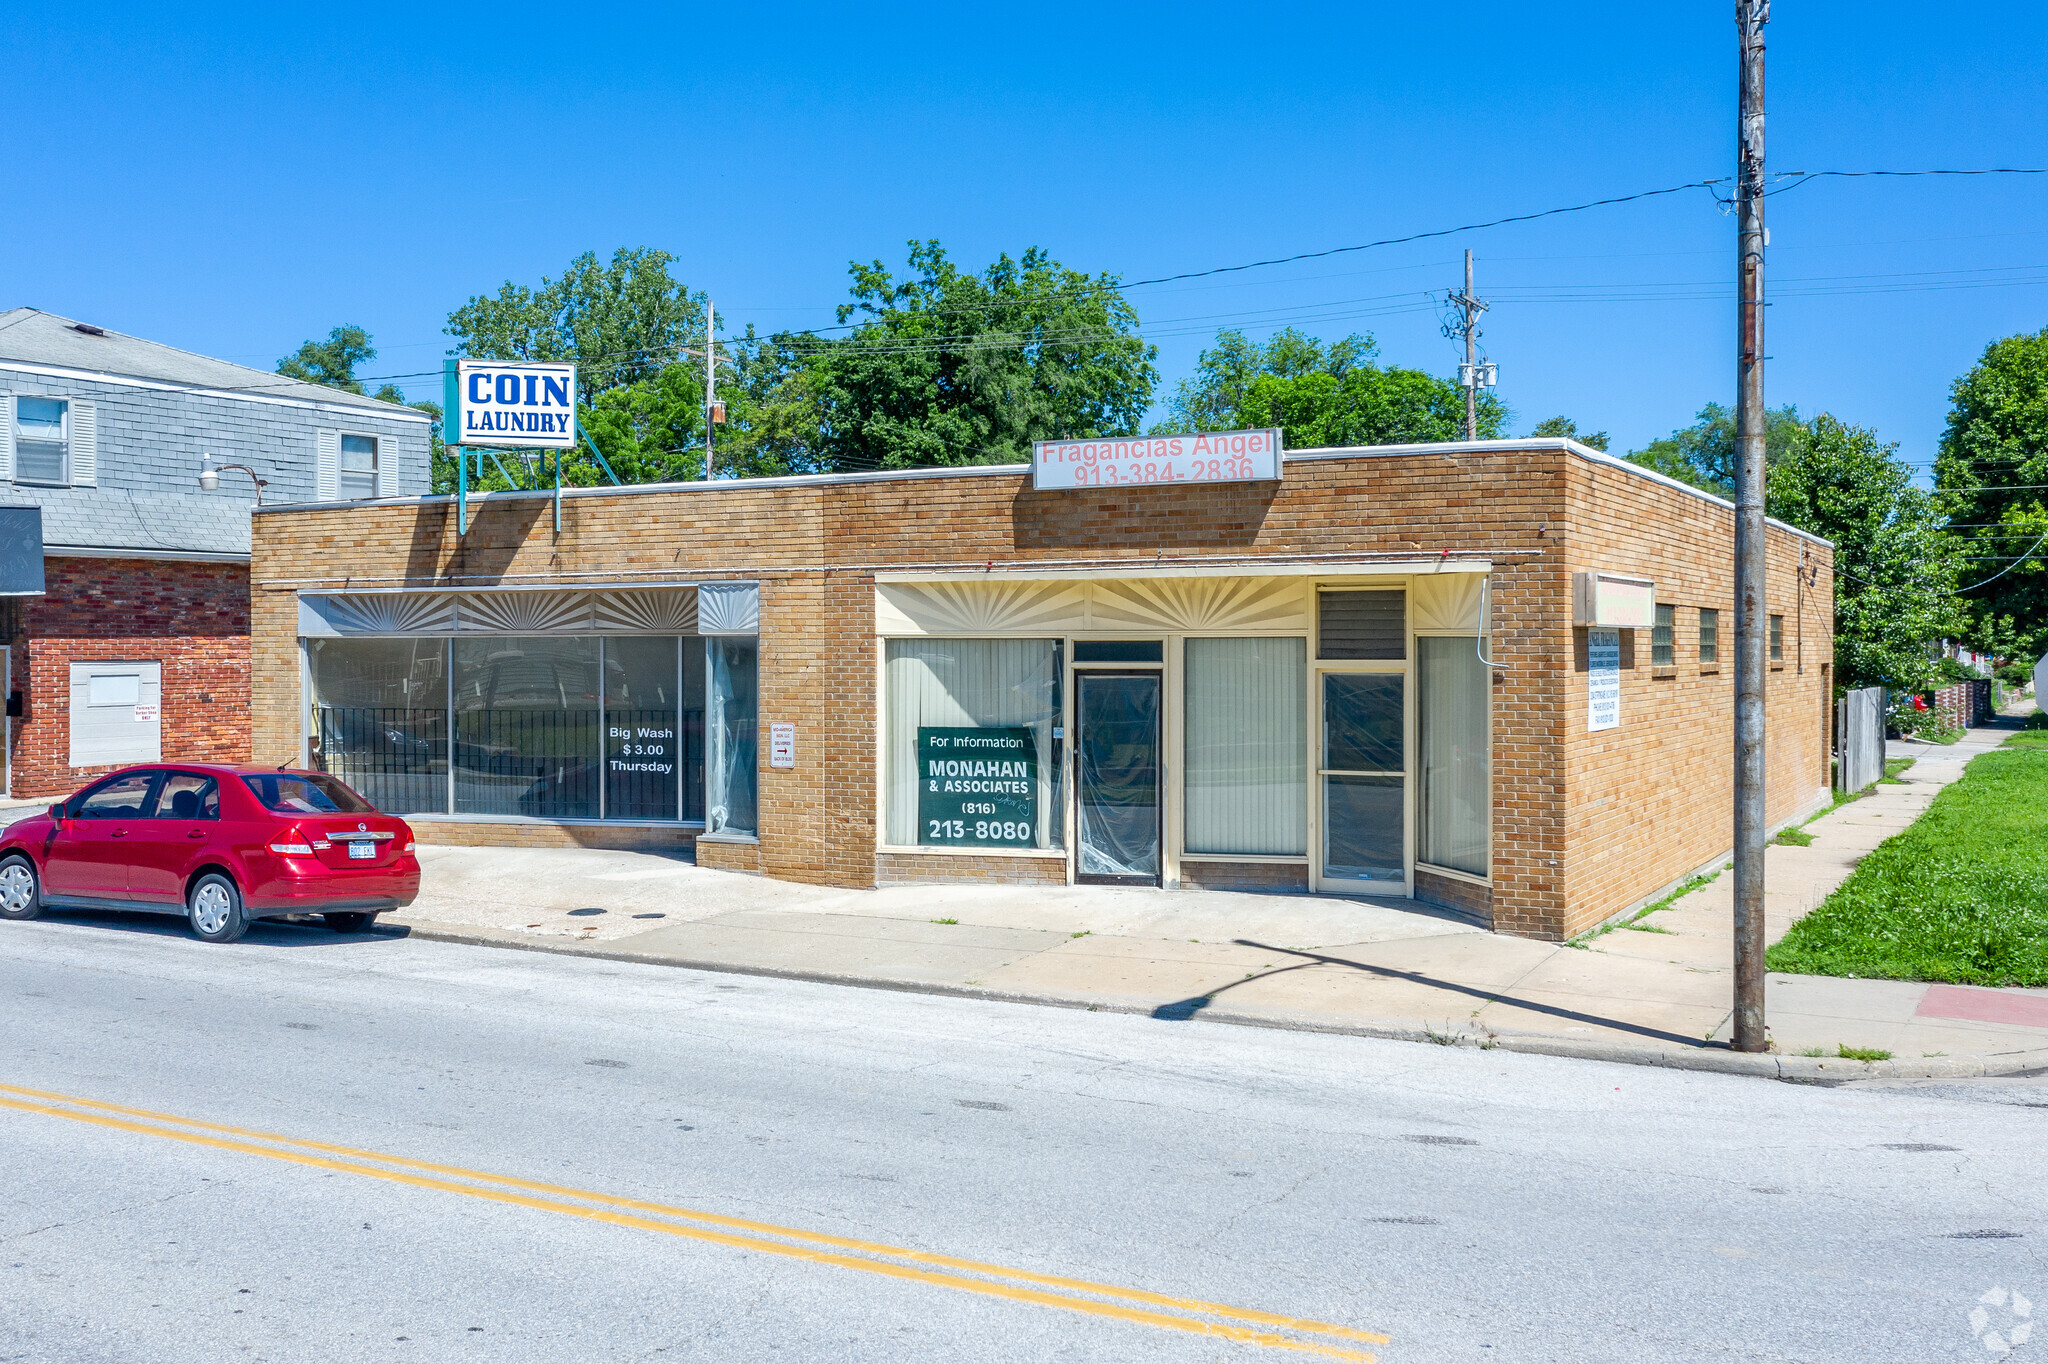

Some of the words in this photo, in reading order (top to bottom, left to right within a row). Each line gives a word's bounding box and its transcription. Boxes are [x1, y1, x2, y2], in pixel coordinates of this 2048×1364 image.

[469, 373, 570, 407] COIN
[466, 410, 570, 433] LAUNDRY
[1042, 437, 1184, 467] Fragancias
[1192, 430, 1271, 460] Angel
[1191, 458, 1254, 481] 2836
[609, 727, 631, 740] Big
[637, 727, 673, 739] Wash
[635, 744, 664, 755] 3.00
[930, 736, 949, 747] For
[953, 736, 1024, 748] Information
[609, 760, 673, 775] Thursday
[929, 760, 1027, 778] MONAHAN
[929, 779, 939, 793] &
[944, 780, 1029, 794] ASSOCIATES
[961, 802, 996, 815] (816)
[929, 819, 1031, 841] 213-8080
